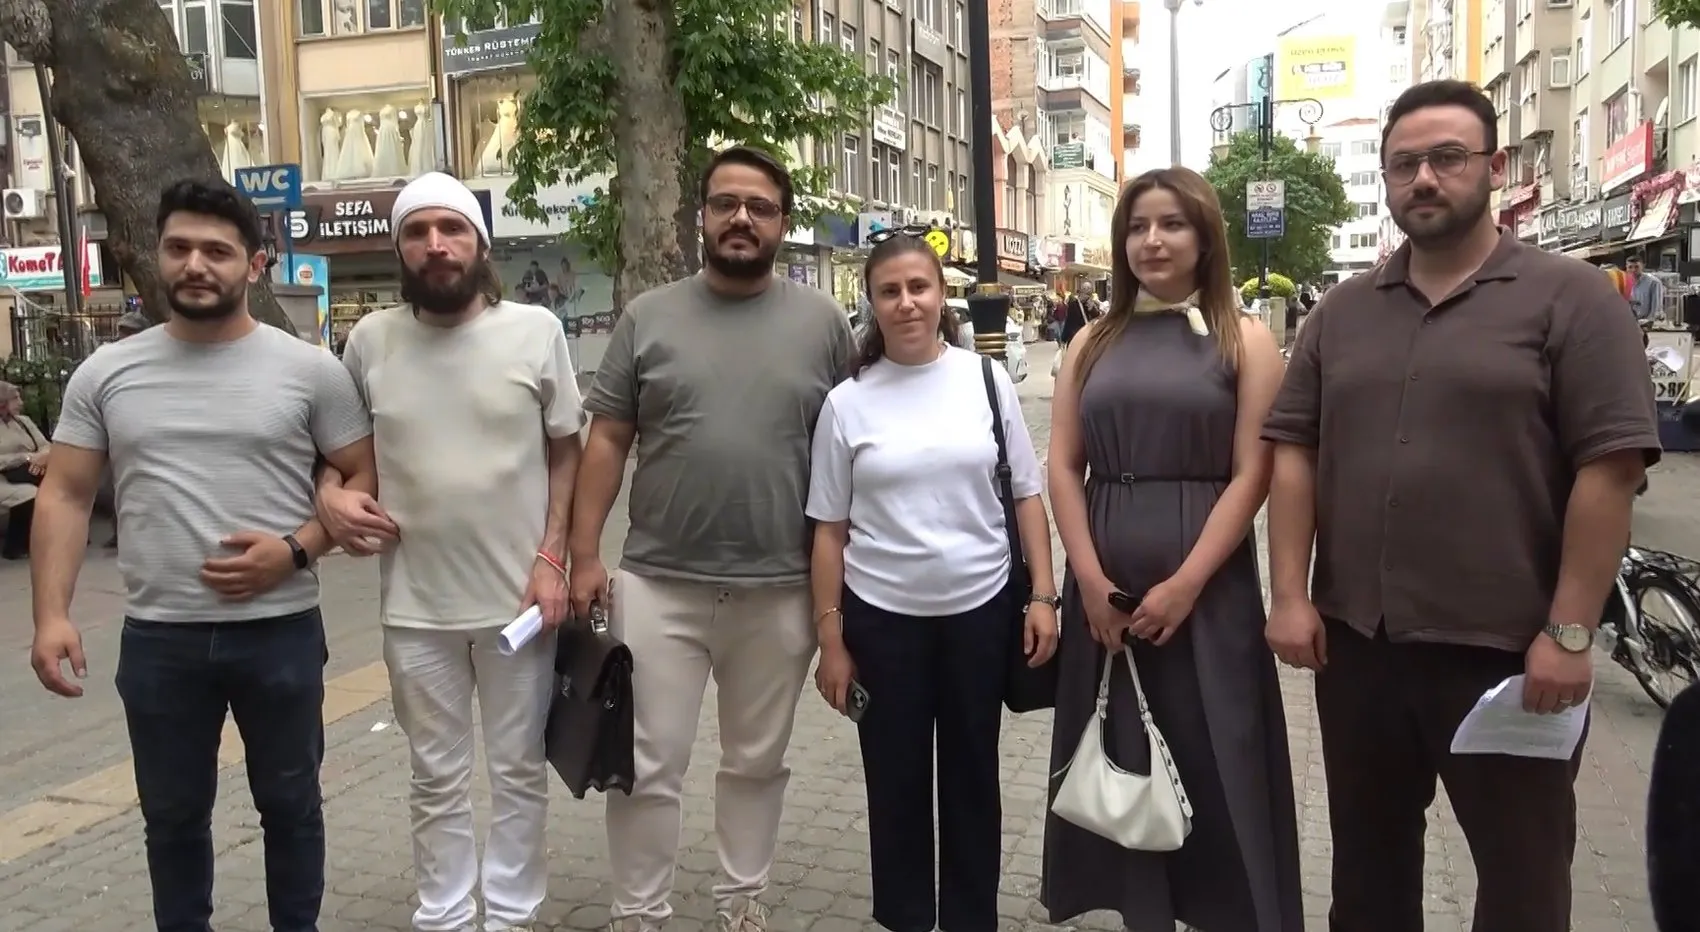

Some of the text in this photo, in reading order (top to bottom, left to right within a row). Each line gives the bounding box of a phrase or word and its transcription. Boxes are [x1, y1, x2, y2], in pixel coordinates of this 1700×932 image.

[240, 168, 290, 193] WC
[335, 200, 374, 217] SEFA
[319, 218, 390, 238] İLETİŞİM
